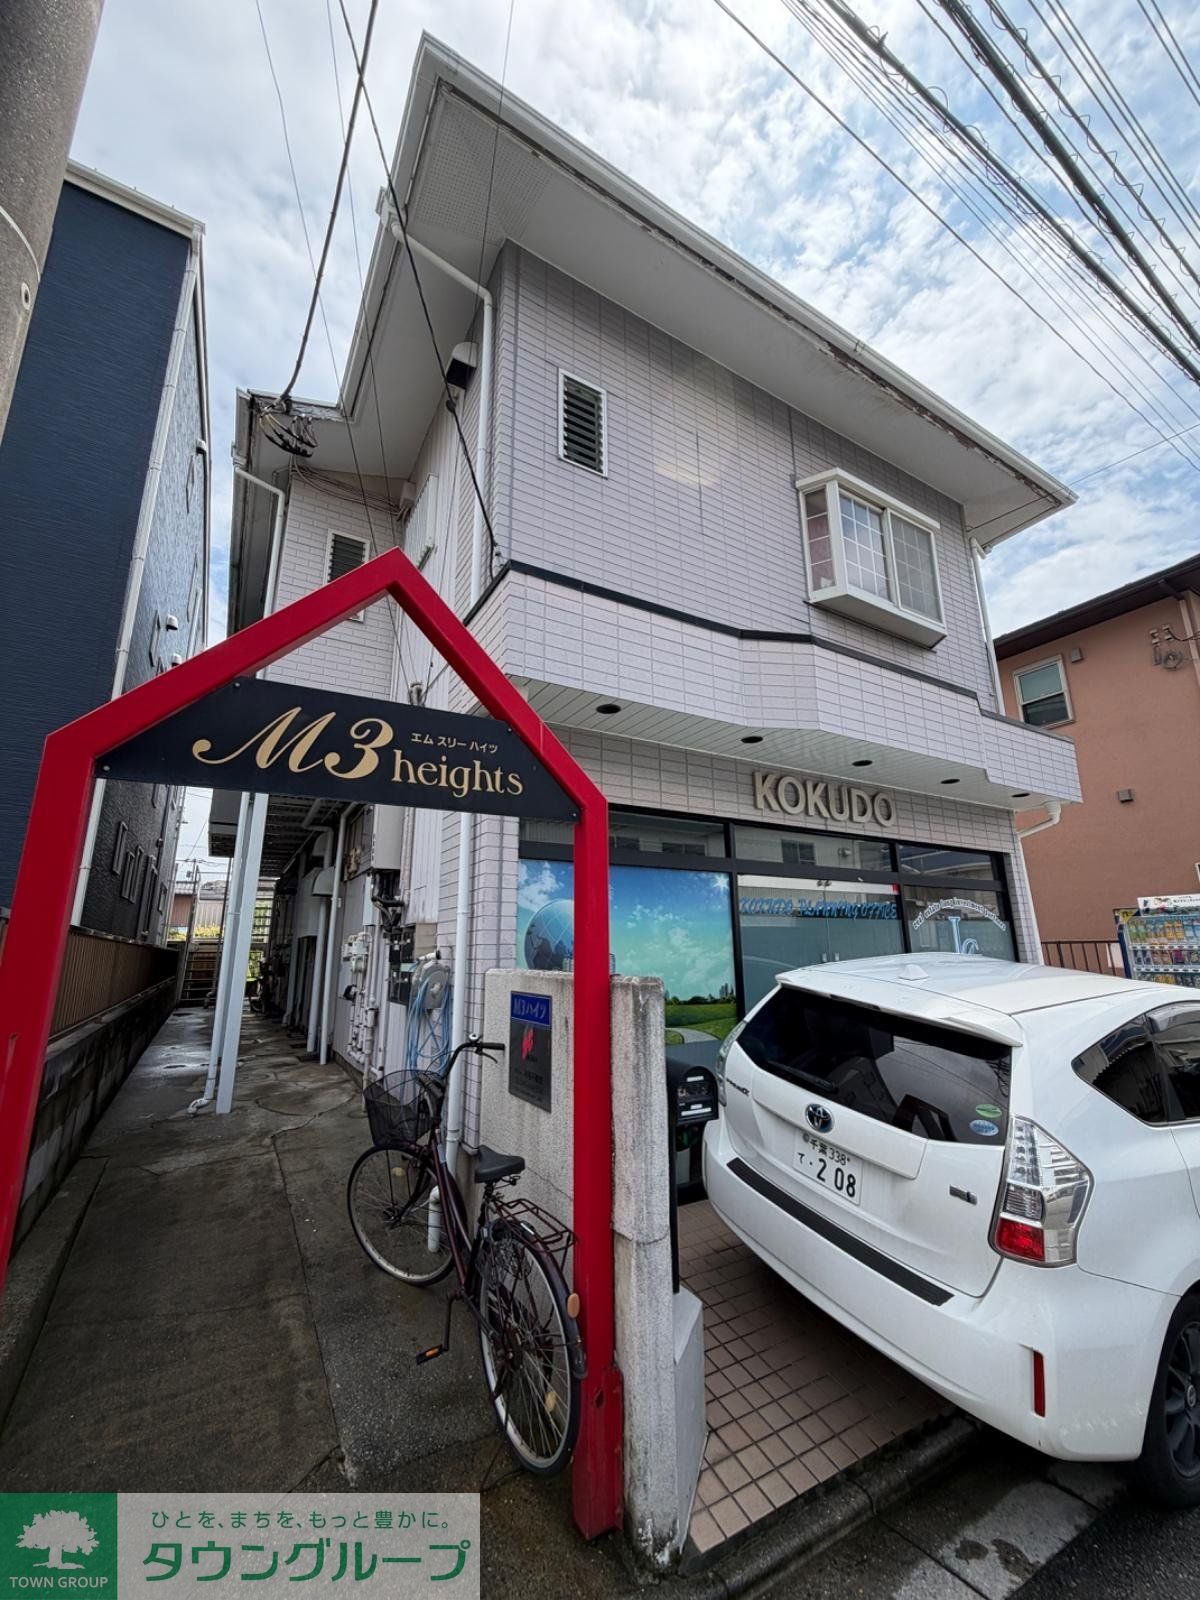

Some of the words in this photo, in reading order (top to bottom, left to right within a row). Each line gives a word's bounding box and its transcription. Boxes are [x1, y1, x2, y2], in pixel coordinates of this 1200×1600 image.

[192, 706, 394, 779] M3
[411, 732, 434, 745] エム
[437, 736, 467, 748] スリー
[469, 741, 498, 754] ハイツ
[391, 749, 524, 798] heights
[753, 771, 897, 828] KOKUDO
